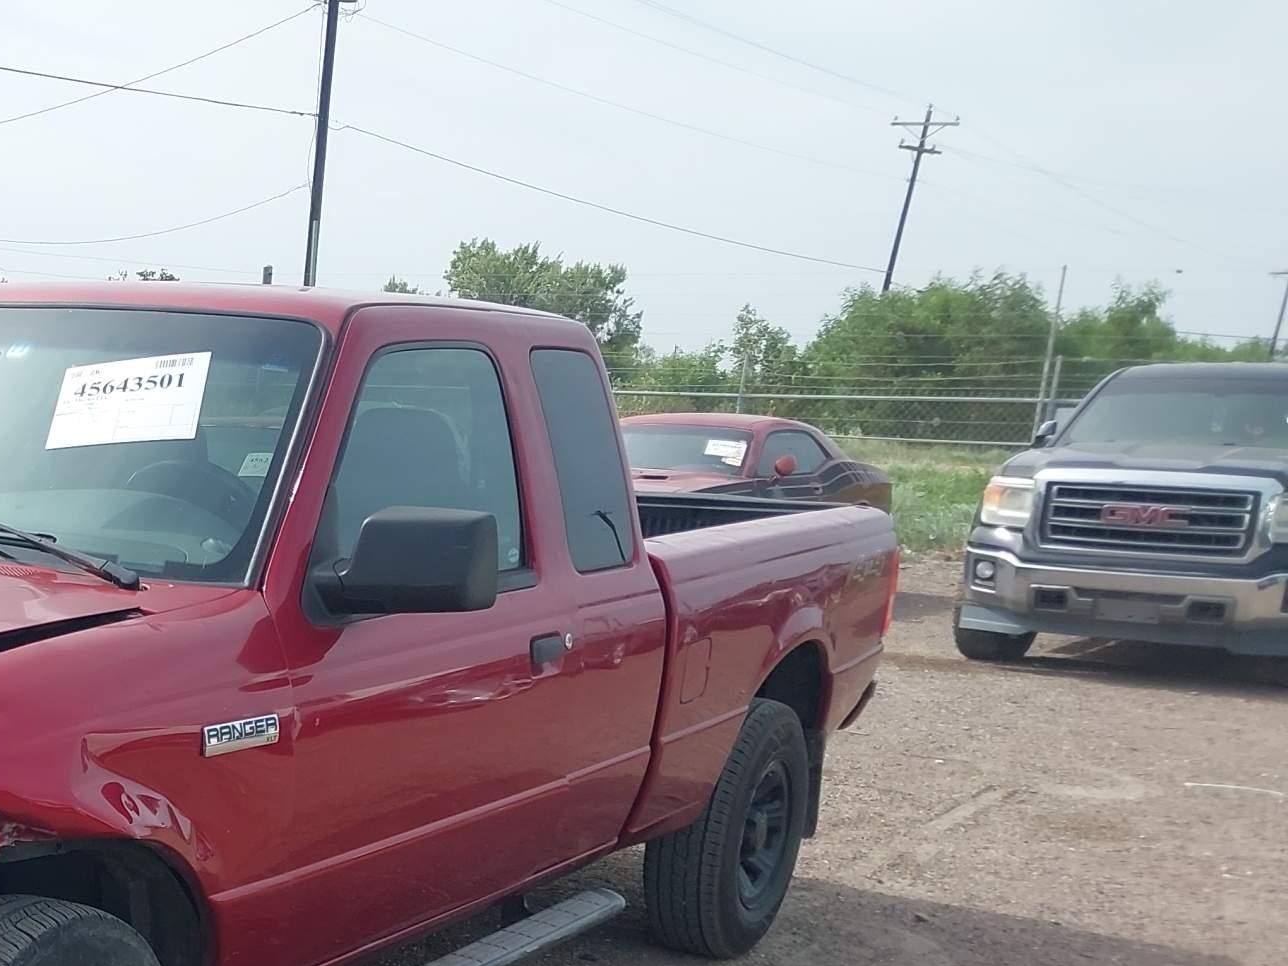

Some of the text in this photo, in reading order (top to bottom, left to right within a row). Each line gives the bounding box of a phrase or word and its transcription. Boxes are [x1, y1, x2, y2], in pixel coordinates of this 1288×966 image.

[73, 372, 185, 397] 45643501
[1101, 504, 1190, 528] GMC
[206, 716, 278, 745] RANGER
